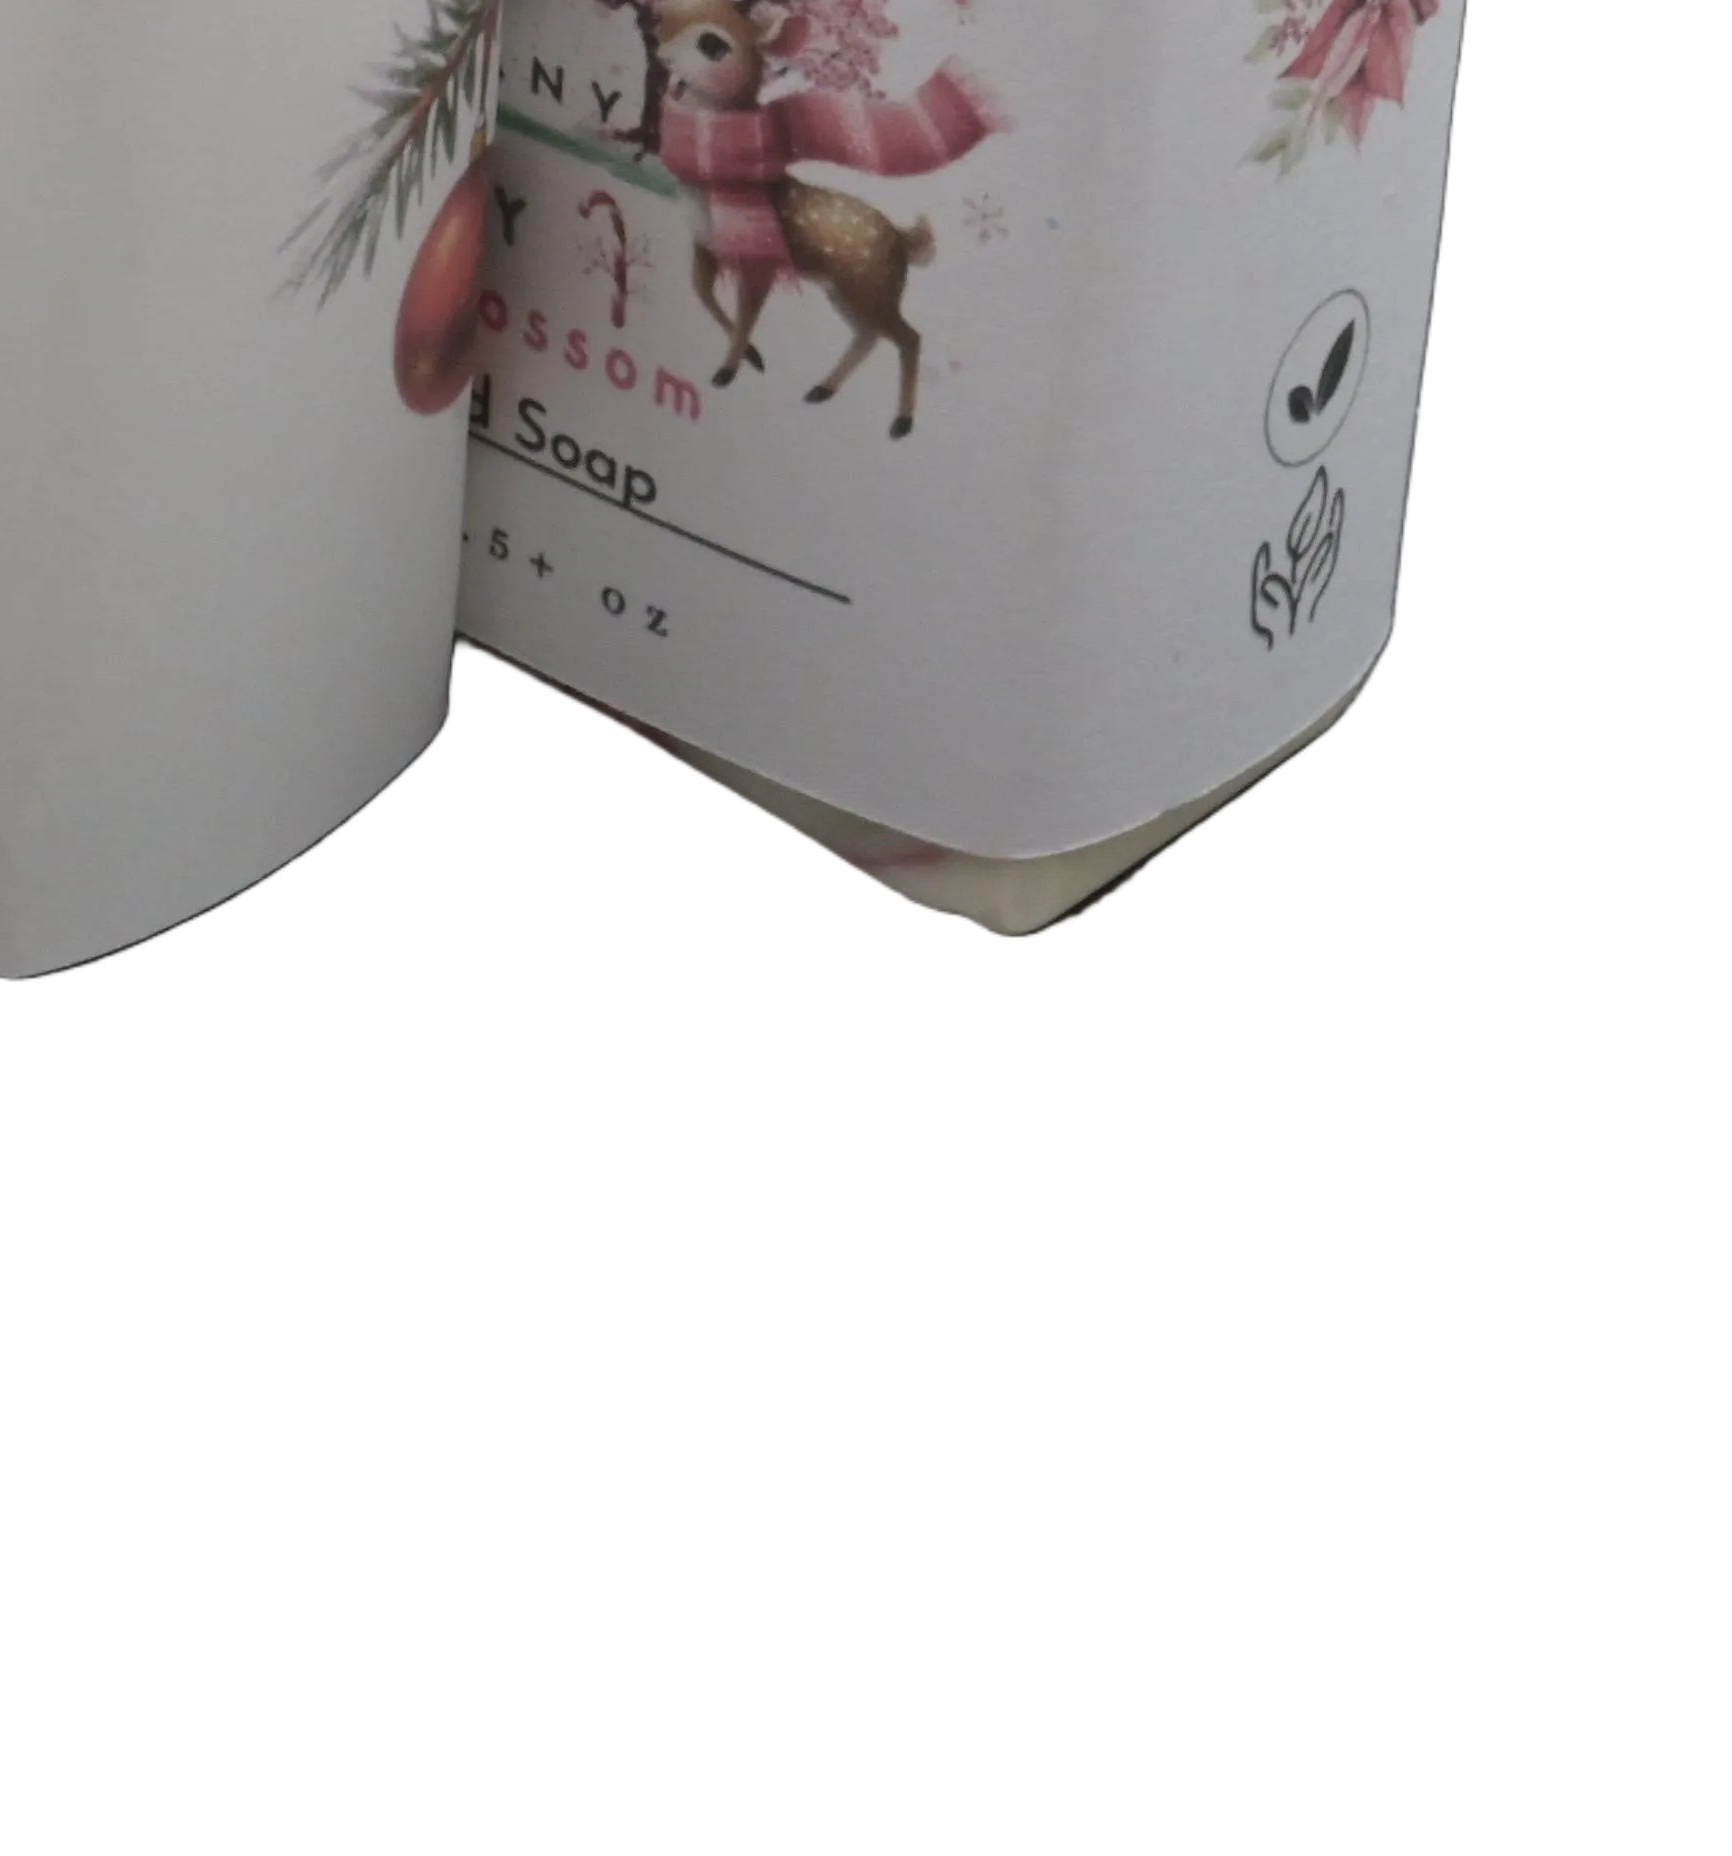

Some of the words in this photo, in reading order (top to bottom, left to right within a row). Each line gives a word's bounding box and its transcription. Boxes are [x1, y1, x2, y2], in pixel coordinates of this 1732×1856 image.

[478, 289, 703, 422] ossom
[513, 396, 659, 511] Soap
[461, 525, 555, 581] .5+
[600, 585, 669, 639] oz
